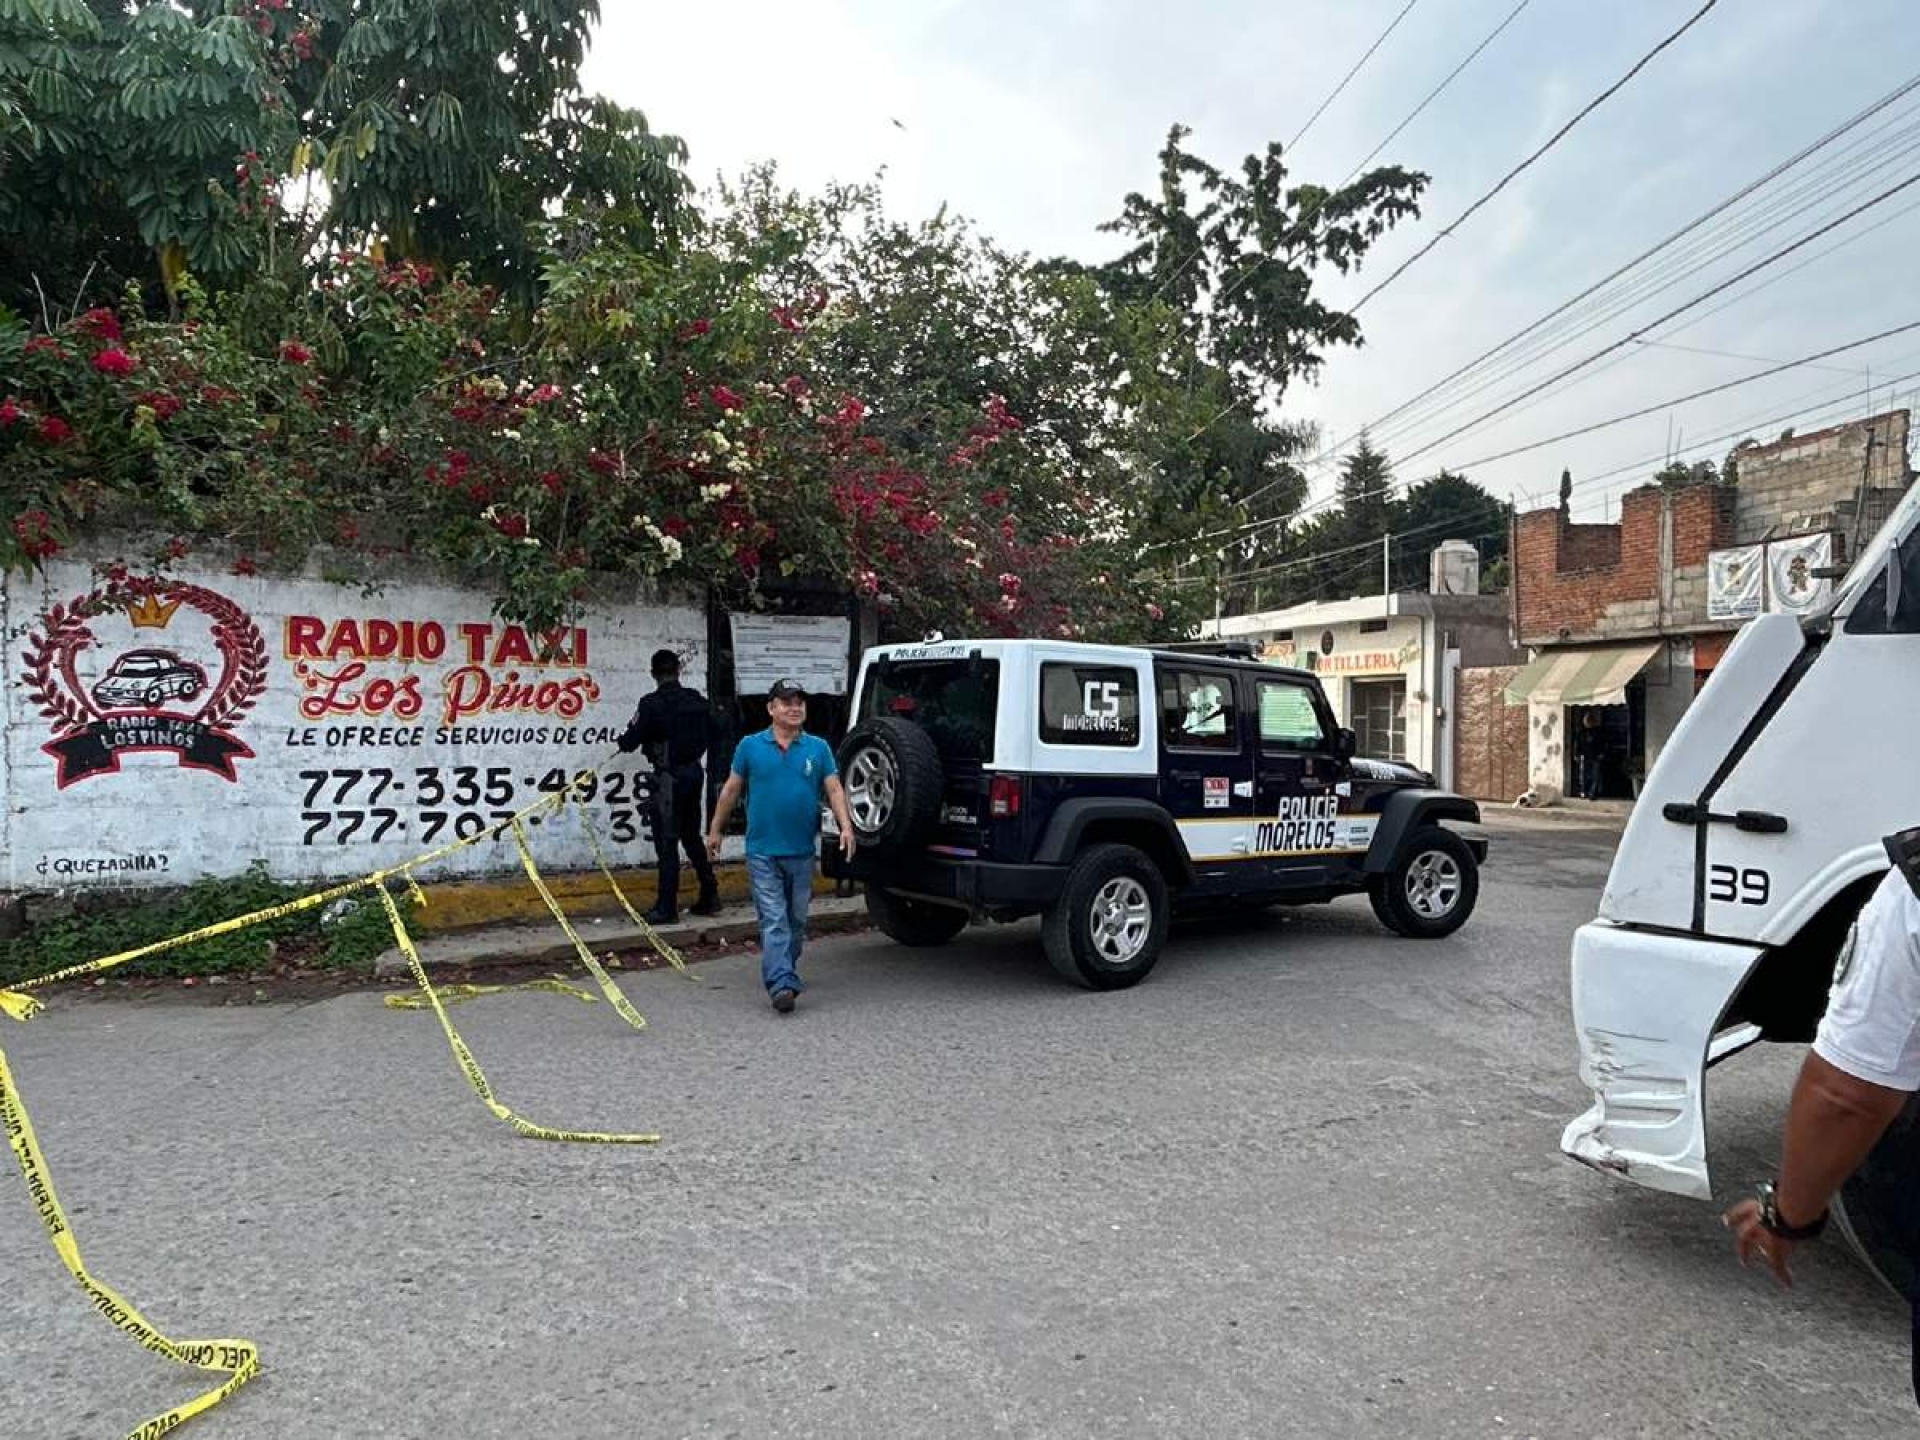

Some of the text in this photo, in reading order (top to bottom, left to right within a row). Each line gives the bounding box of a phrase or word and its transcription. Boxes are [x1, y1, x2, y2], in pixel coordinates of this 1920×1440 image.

[284, 615, 588, 666] RADIO TAXI
[1315, 652, 1398, 673] ORTILLERIA
[107, 716, 157, 731] RADIO
[286, 725, 620, 747] LE OFRECE SERVICIOS DE CAL
[1256, 821, 1336, 852] MORELOS
[1709, 864, 1770, 906] 39
